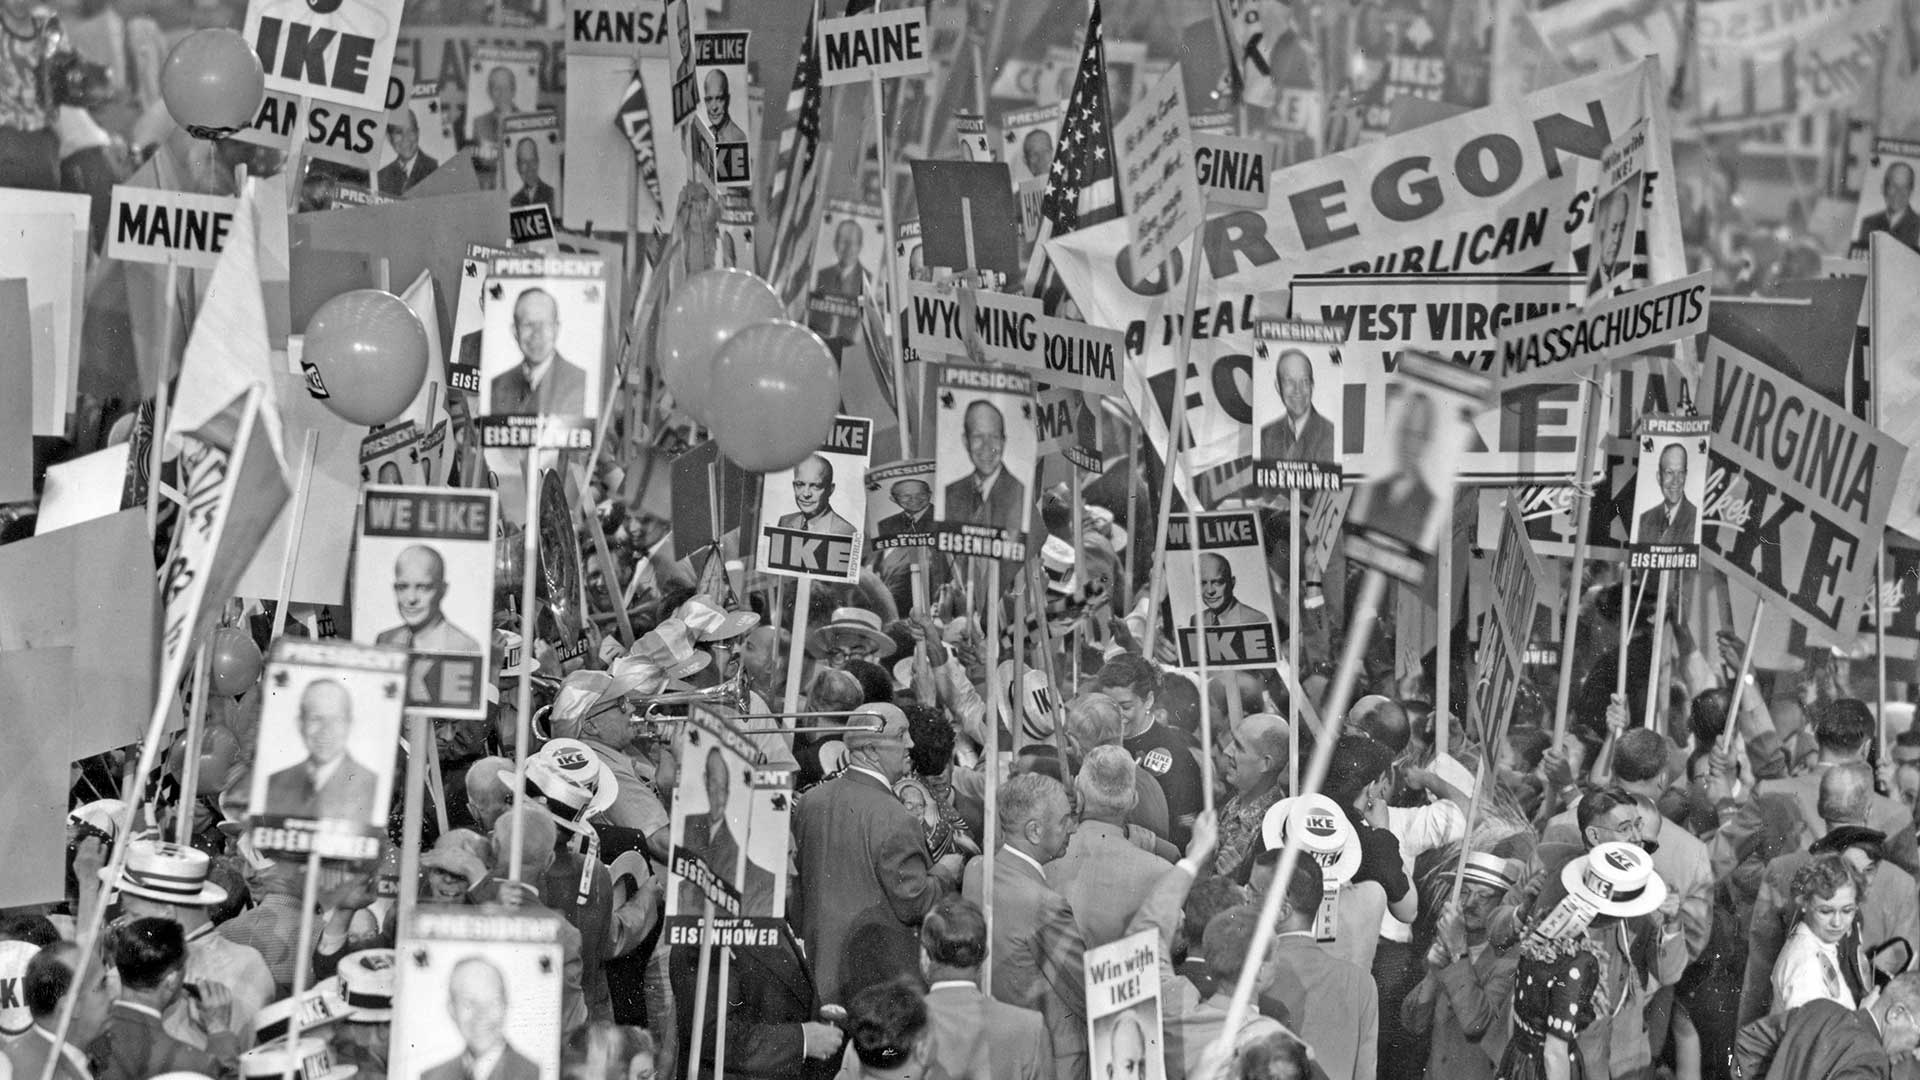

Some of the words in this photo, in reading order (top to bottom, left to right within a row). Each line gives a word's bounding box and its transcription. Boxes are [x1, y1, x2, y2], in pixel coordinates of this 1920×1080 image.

[255, 16, 376, 95] IKE
[714, 38, 743, 60] LIKE
[825, 21, 922, 71] MAINE
[1195, 147, 1264, 193] GINIA
[117, 201, 234, 254] MAINE
[512, 215, 546, 240] IKE
[1260, 321, 1345, 342] PRESIDENT
[1320, 302, 1416, 341] WEST
[1427, 302, 1577, 341] VIRGI
[1501, 284, 1706, 378] MASSACHUSETTS
[945, 367, 1031, 392] PRESIDENT
[1342, 382, 1581, 455] IE
[1647, 418, 1711, 434] PRESIDENT
[821, 424, 865, 450] IKE
[1710, 354, 1878, 526] VIRGINIA
[1256, 467, 1340, 490] EISENHOWER
[368, 497, 412, 530] WE
[418, 499, 486, 534] LIKE
[1203, 520, 1253, 543] LIKE
[770, 532, 852, 573] IKE
[938, 531, 1026, 562] EISENHOWER
[1631, 552, 1699, 569] EISENHOWER
[1186, 629, 1269, 663] IKE
[556, 752, 586, 766] IKE
[1306, 817, 1335, 829] IKE
[1610, 850, 1634, 871] IKE
[698, 919, 740, 928] DIGHT
[671, 927, 779, 947] EISNHOWER
[1091, 960, 1121, 984] Win
[1111, 974, 1141, 1005] IKE!
